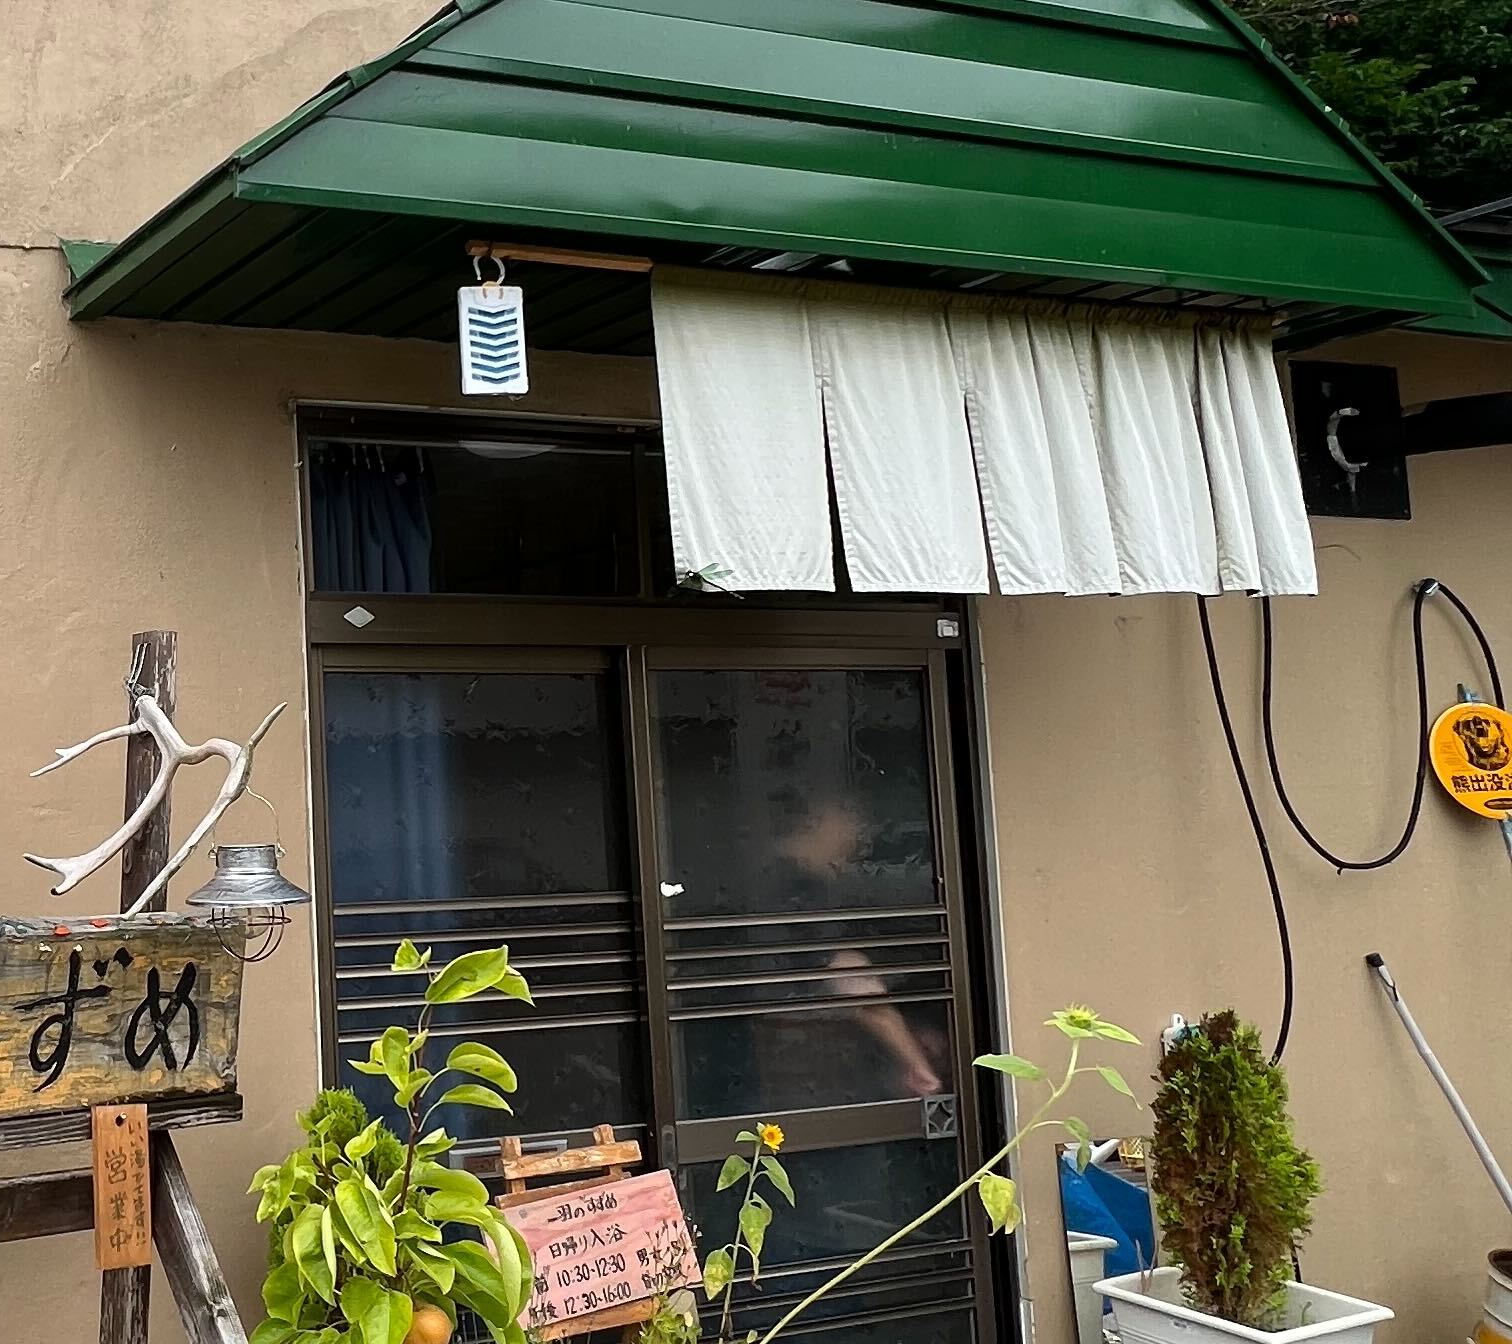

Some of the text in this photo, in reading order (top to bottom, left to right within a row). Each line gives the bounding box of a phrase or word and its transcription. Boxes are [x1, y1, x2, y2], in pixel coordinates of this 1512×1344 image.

[1451, 774, 1512, 793] 熊出没
[104, 1146, 131, 1253] 営業中
[549, 1222, 628, 1260] 日帰り入浴
